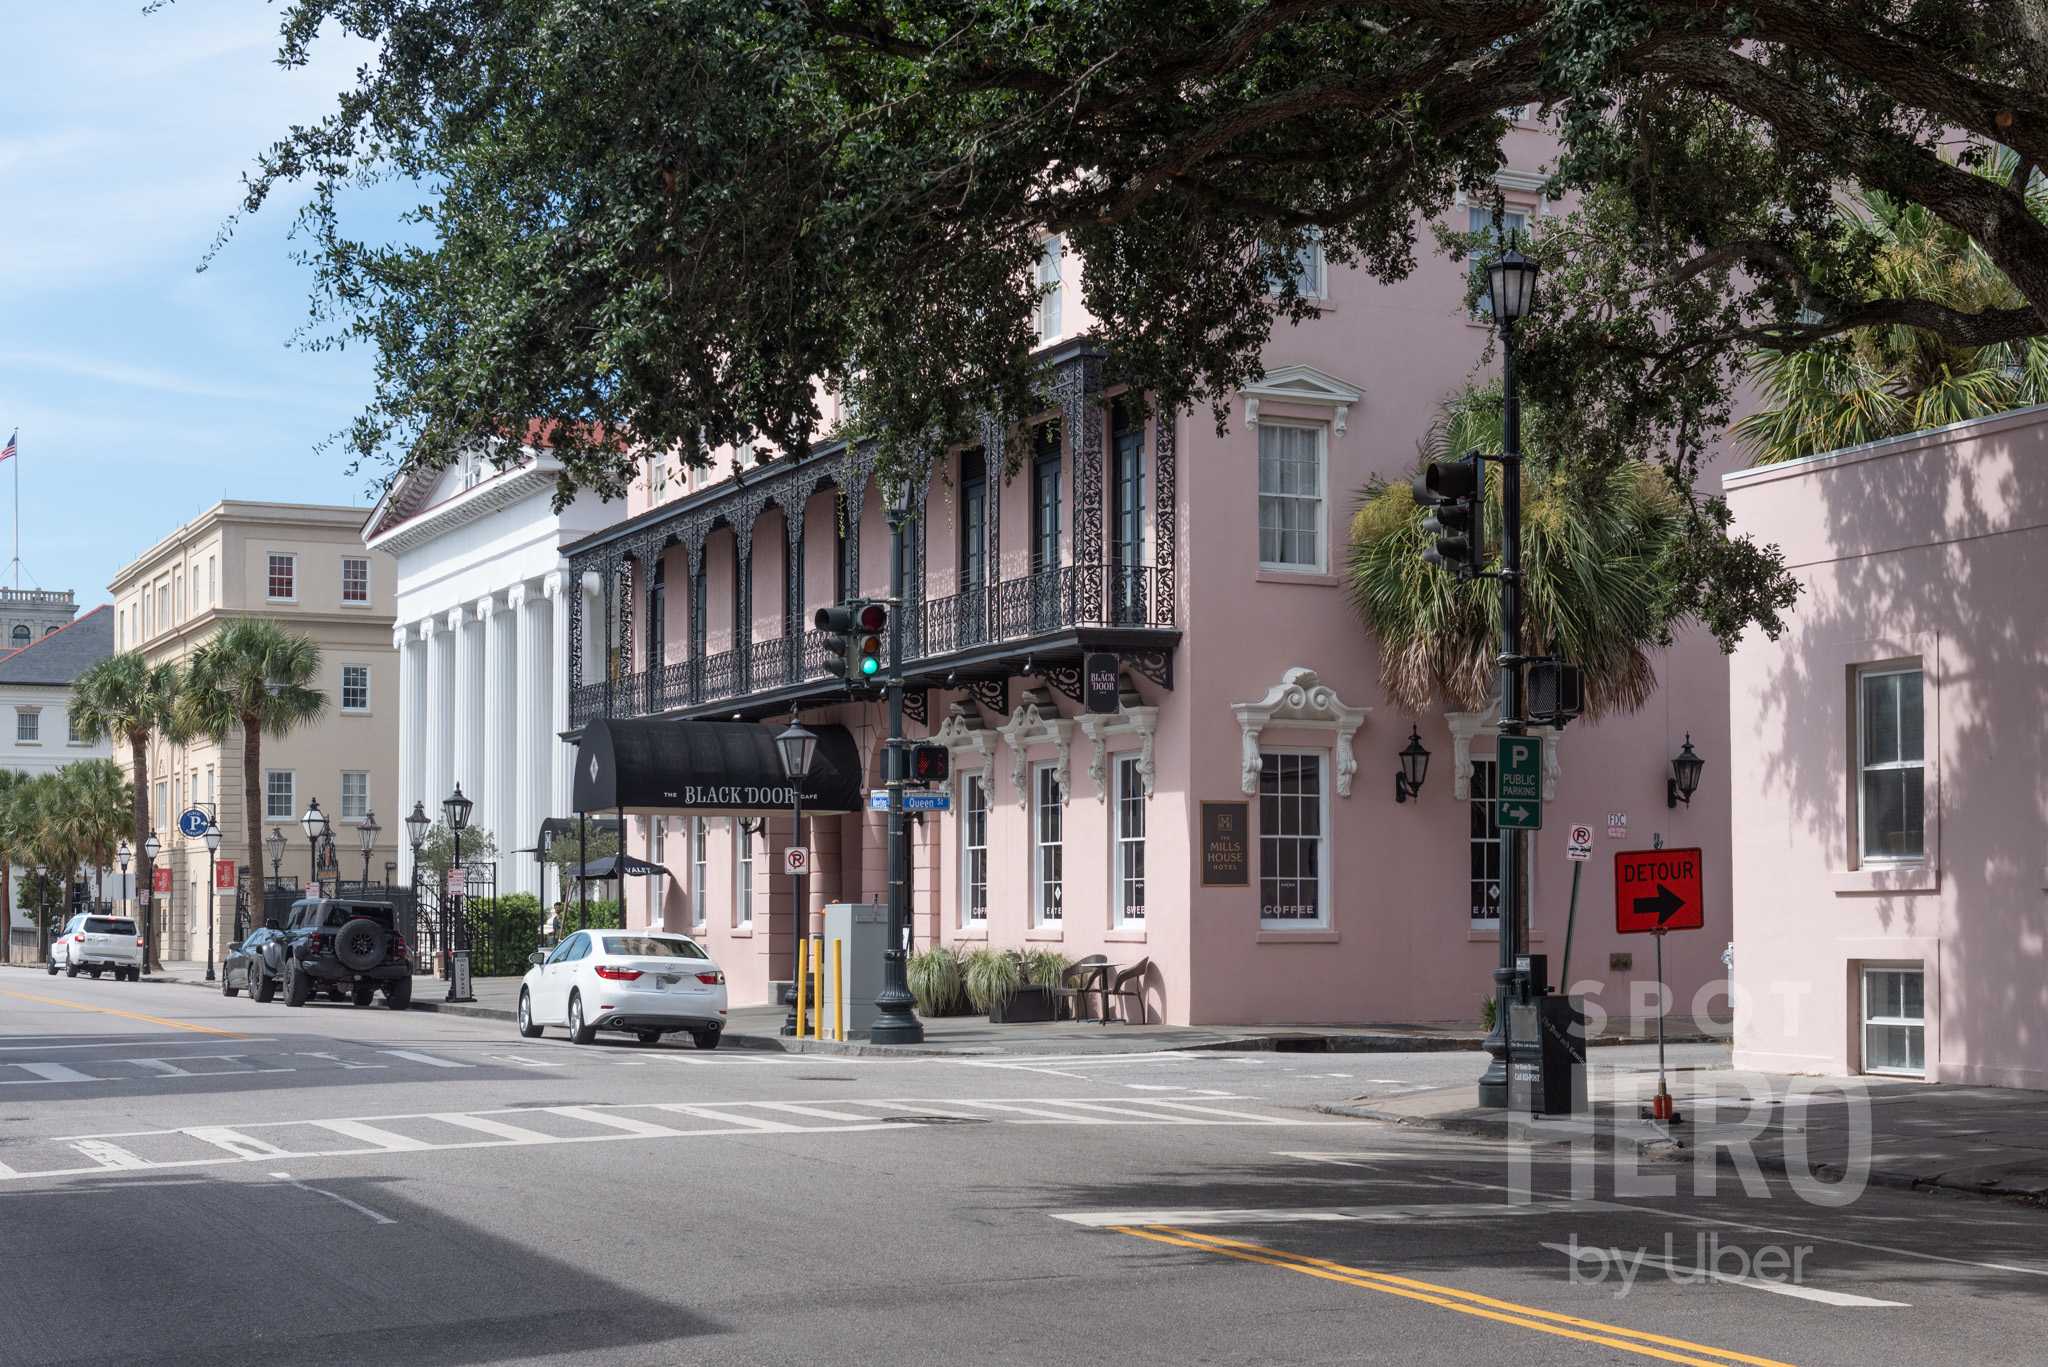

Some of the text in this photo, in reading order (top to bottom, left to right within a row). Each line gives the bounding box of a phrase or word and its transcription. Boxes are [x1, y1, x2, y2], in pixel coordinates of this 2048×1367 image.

[1091, 673, 1115, 682] BLACK
[1092, 682, 1114, 691] DOOR
[1512, 746, 1529, 768] P
[1503, 774, 1536, 786] PUBLIC
[685, 786, 742, 804] BLACK
[744, 787, 795, 804] DOOR
[1503, 786, 1537, 797] PARKING
[909, 797, 934, 808] Queen
[190, 816, 201, 831] P
[1609, 814, 1625, 825] FDC
[1210, 841, 1241, 852] MILLS
[1207, 852, 1243, 863] HOUSE
[625, 866, 651, 875] VALET
[1624, 861, 1694, 883] DETOUR
[1263, 905, 1314, 914] COFFEE
